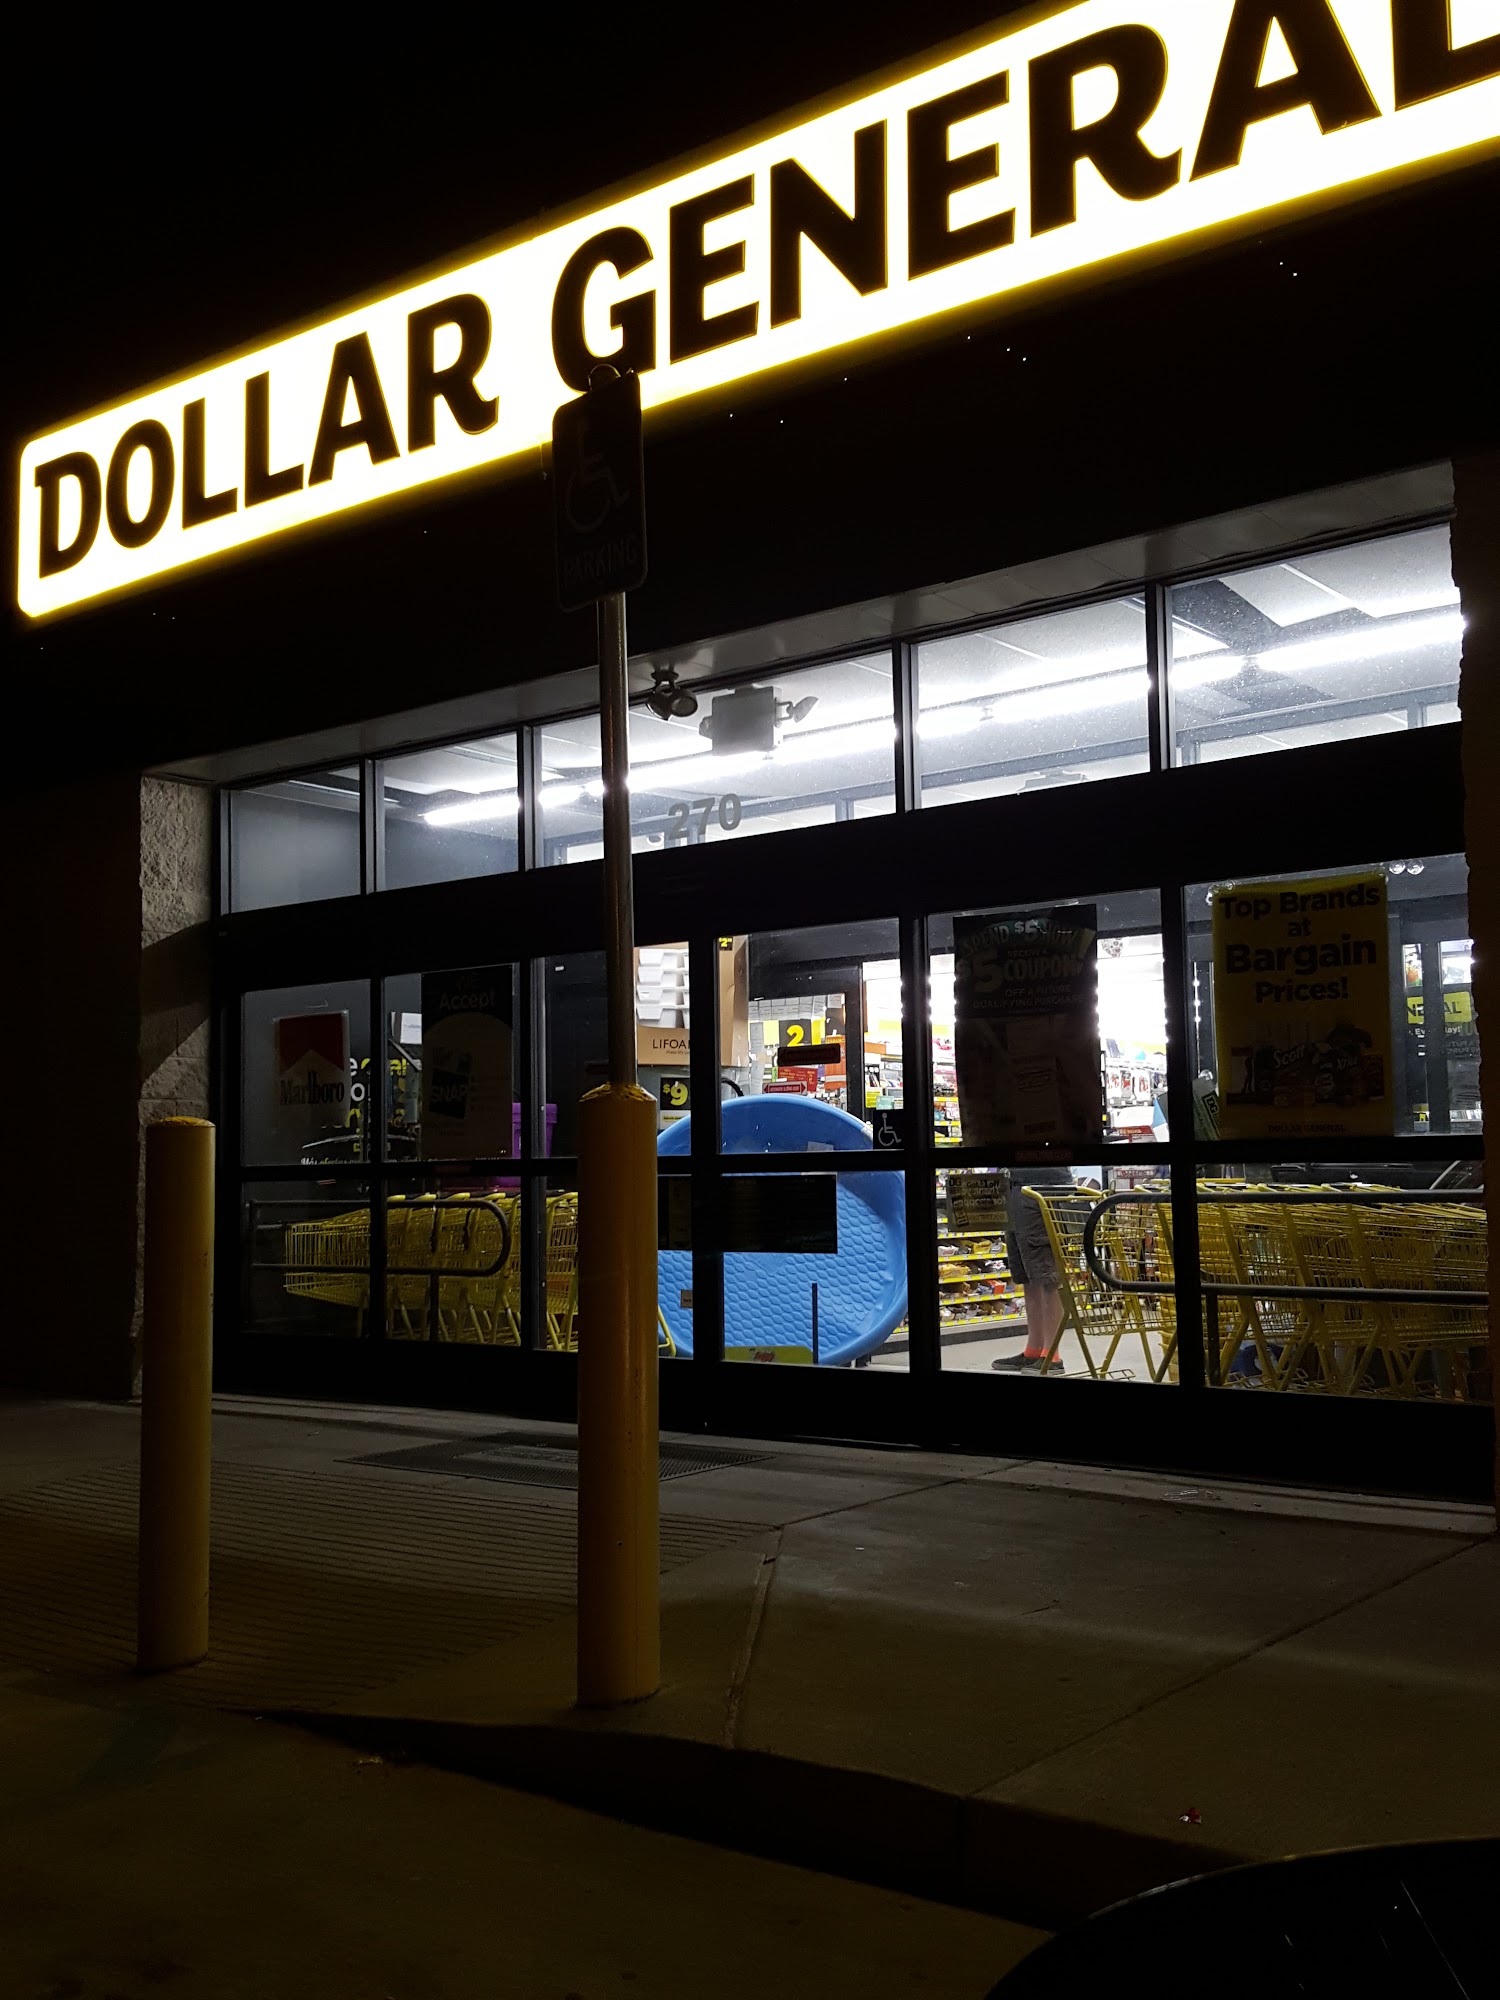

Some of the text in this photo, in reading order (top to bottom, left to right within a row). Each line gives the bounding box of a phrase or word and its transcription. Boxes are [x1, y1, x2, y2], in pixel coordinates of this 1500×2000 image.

[34, 0, 1500, 579] DOLLAR GENERAL
[561, 531, 637, 590] PARKING
[668, 793, 742, 841] 270
[1219, 883, 1380, 920] Top Brands
[1287, 916, 1312, 937] at
[1225, 934, 1377, 975] Bargain
[440, 987, 496, 1010] Accept
[1255, 976, 1349, 1004] Prices!
[652, 1038, 690, 1049] LIFOA
[1273, 1044, 1305, 1068] Scott
[280, 1070, 344, 1106] Marlboro
[663, 1083, 688, 1106] $9
